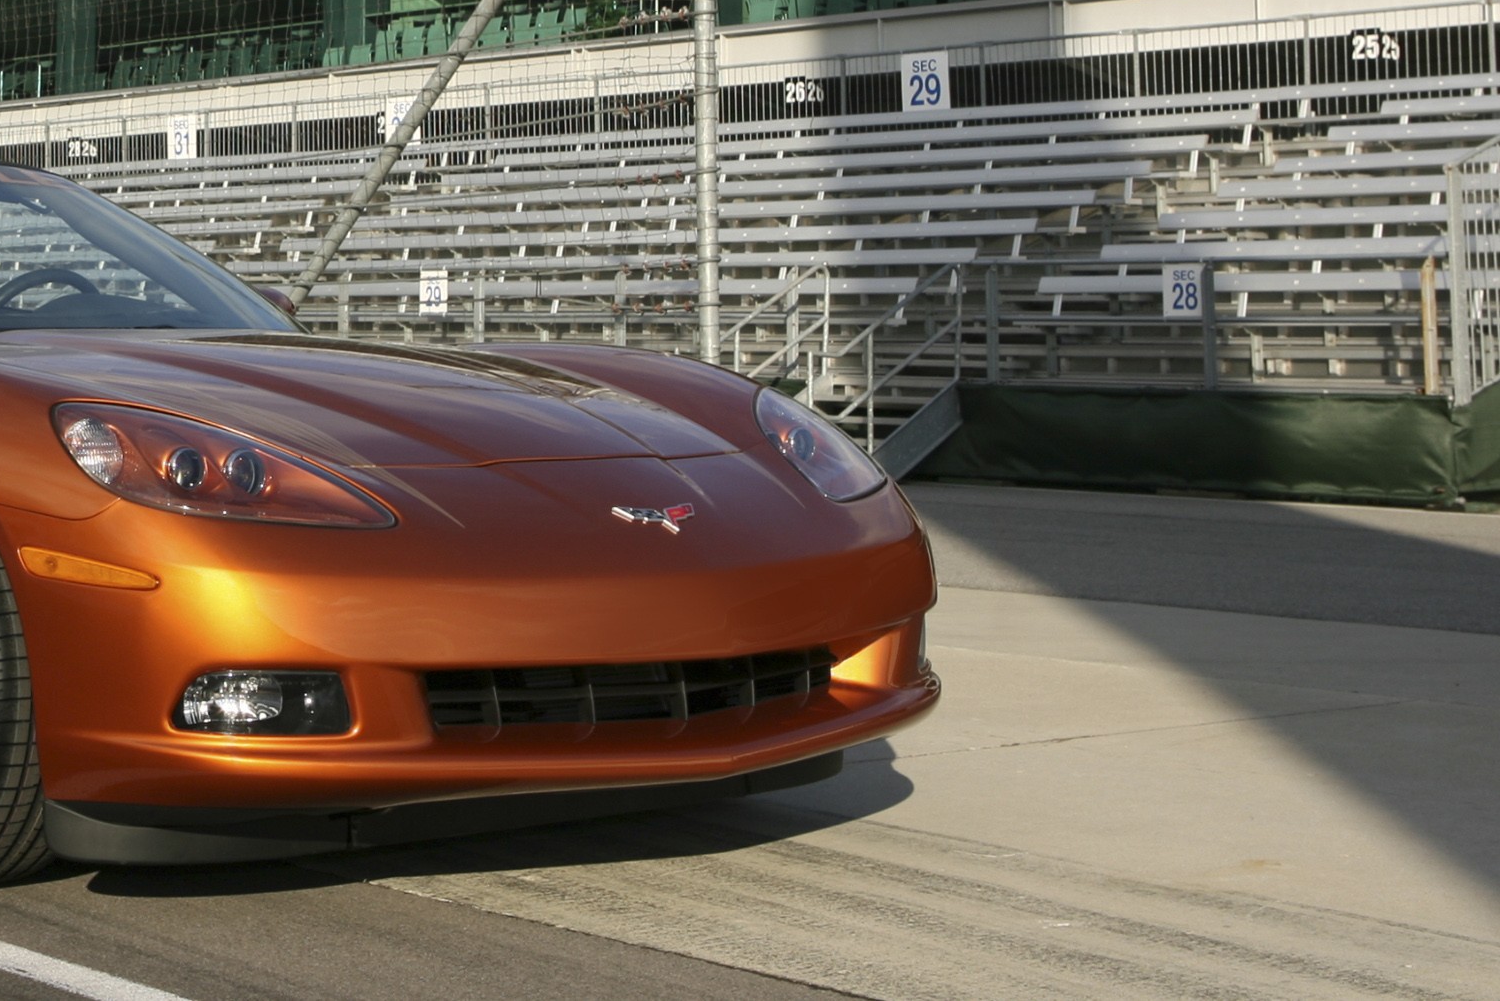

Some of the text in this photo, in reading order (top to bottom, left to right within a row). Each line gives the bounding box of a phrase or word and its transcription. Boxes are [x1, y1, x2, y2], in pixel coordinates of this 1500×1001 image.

[1352, 34, 1380, 60] 25
[912, 59, 937, 73] SEC
[785, 81, 805, 103] 26
[910, 73, 941, 106] 29
[174, 120, 189, 129] SEC
[377, 115, 385, 134] 2
[174, 131, 190, 155] 31
[1173, 270, 1195, 281] SEC
[426, 286, 441, 307] 29
[1172, 282, 1198, 310] 28
